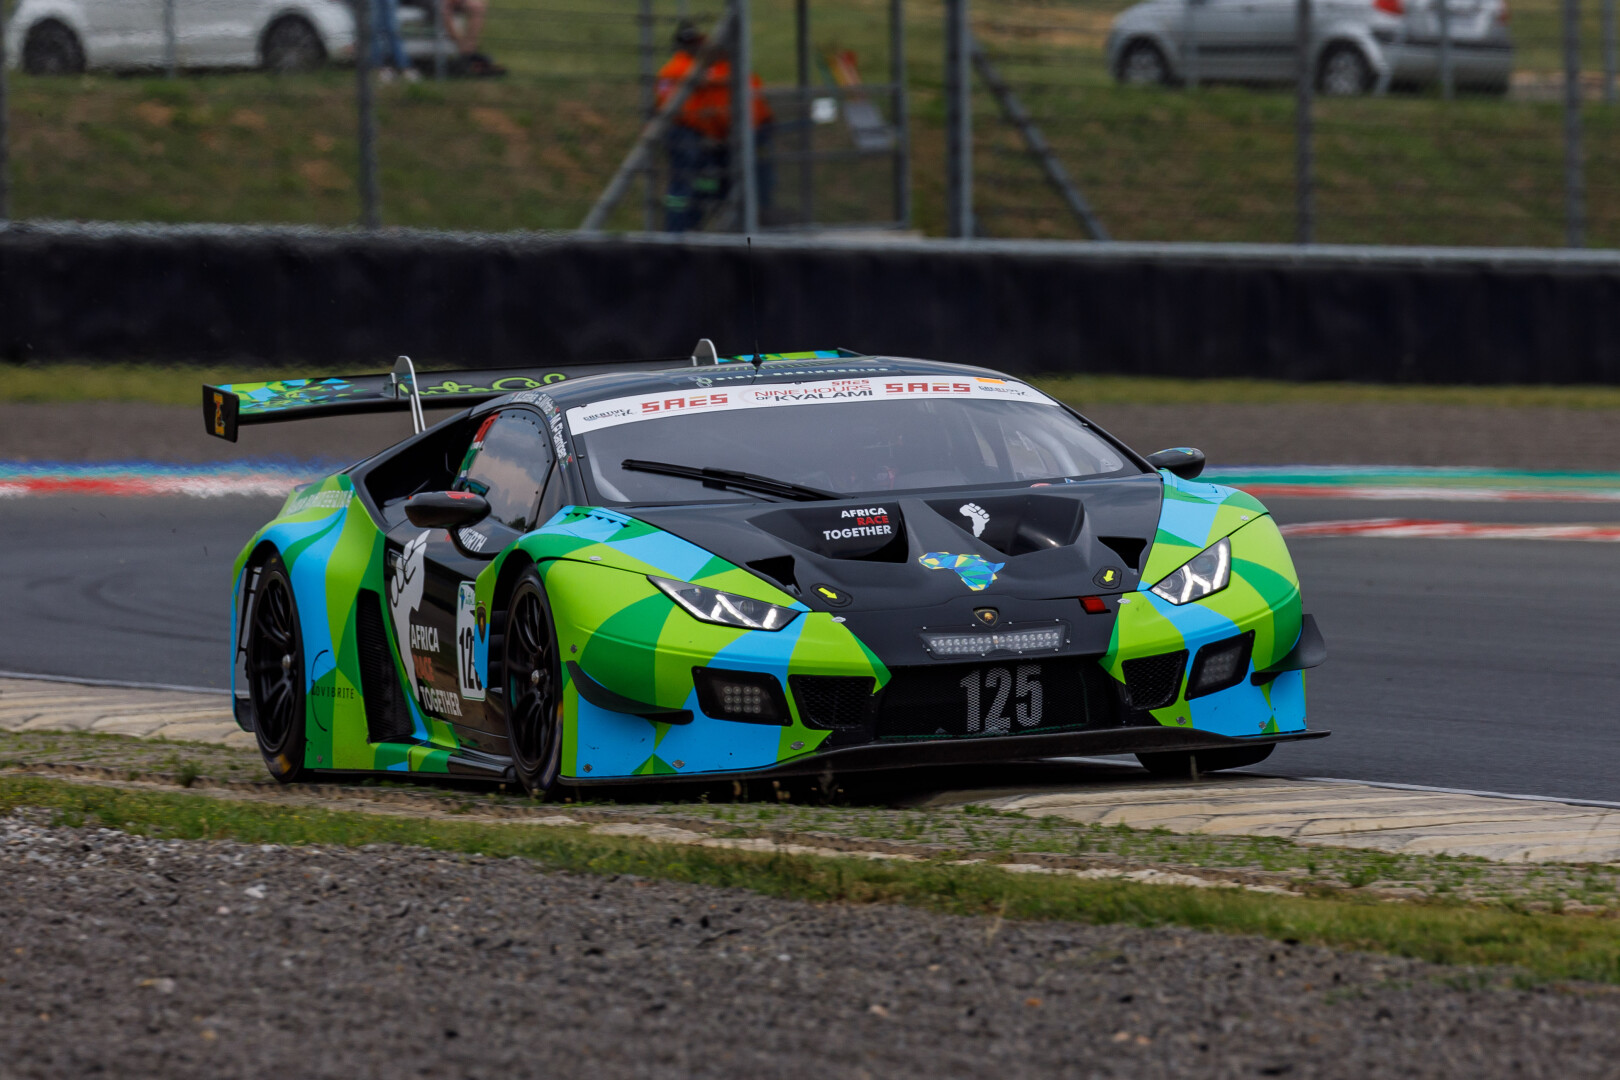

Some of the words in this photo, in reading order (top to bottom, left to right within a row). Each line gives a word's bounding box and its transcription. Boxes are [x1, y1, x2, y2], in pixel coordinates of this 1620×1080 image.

[755, 389, 800, 397] NINE
[804, 385, 872, 395] HOURS
[884, 382, 971, 393] SAES
[775, 390, 873, 402] KYALAMI
[641, 393, 728, 413] SAES
[841, 507, 888, 518] AFRICA
[856, 515, 889, 526] RACE
[823, 525, 892, 540] TOGETHER
[411, 624, 440, 653] AFRICA
[420, 686, 463, 716] TOGETHER
[960, 664, 1042, 733] 125
